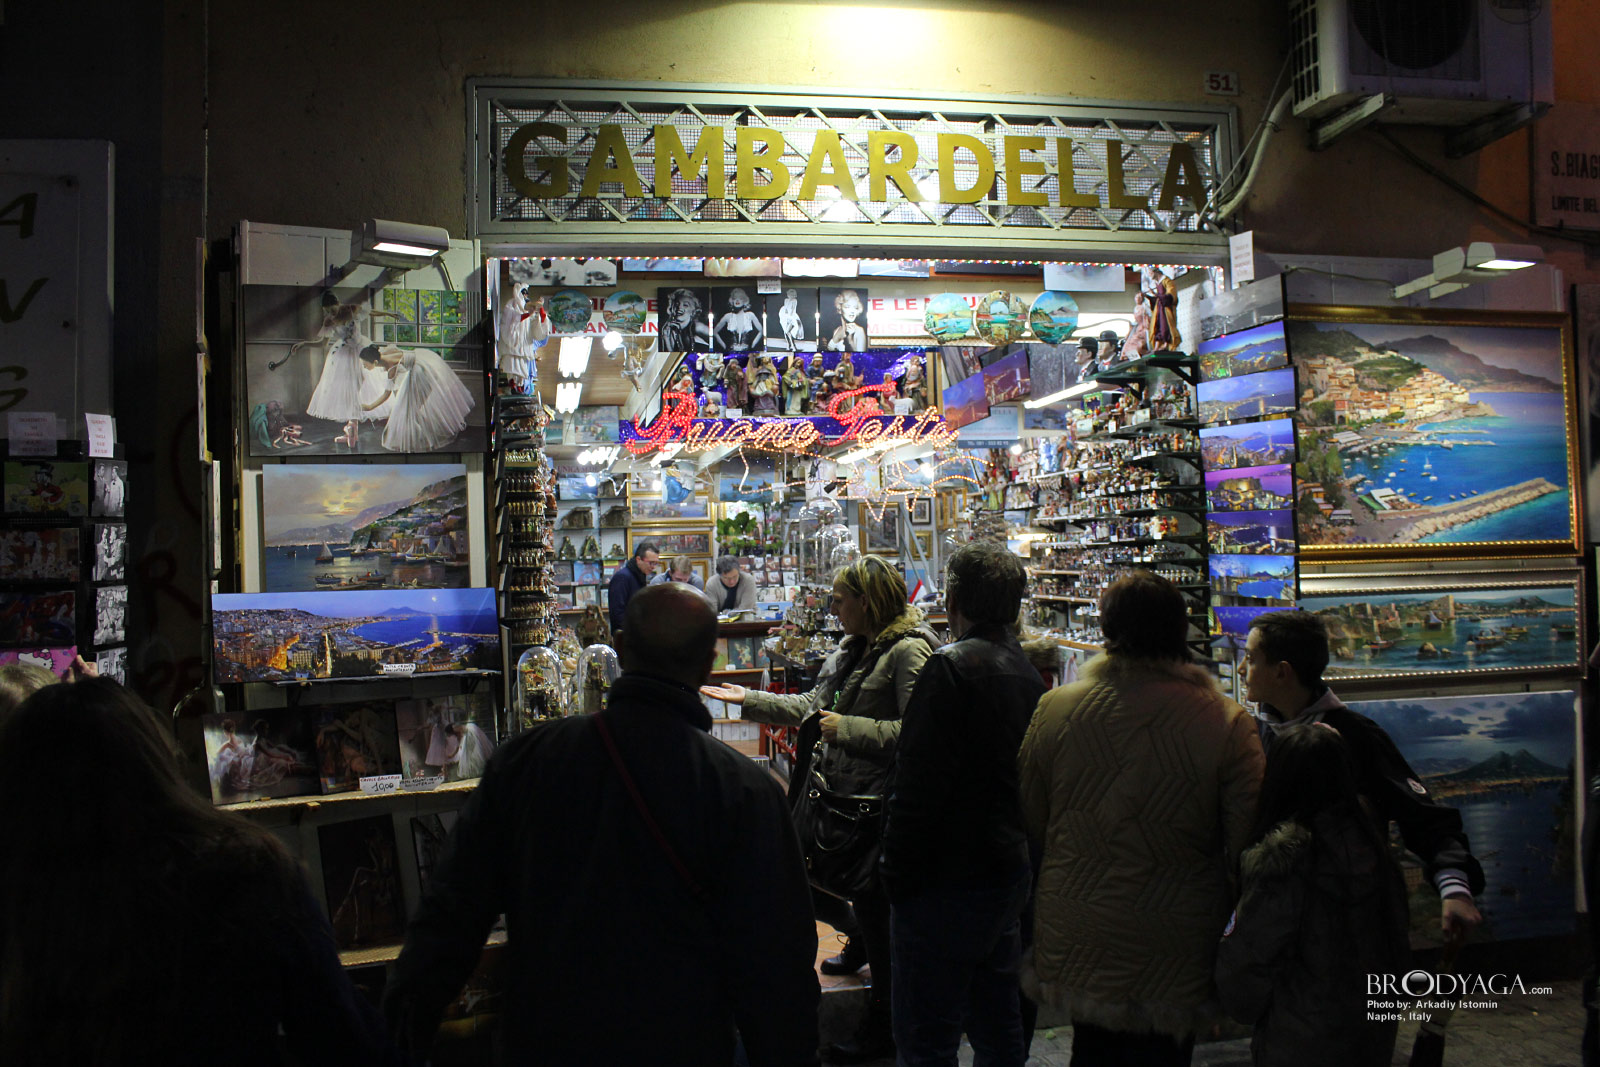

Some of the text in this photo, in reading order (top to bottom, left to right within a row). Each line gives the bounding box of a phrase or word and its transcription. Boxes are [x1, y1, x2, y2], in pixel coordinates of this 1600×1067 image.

[1209, 74, 1233, 91] 51
[506, 121, 1213, 212] GAMBARDELLA
[625, 381, 961, 455] Buone Feste
